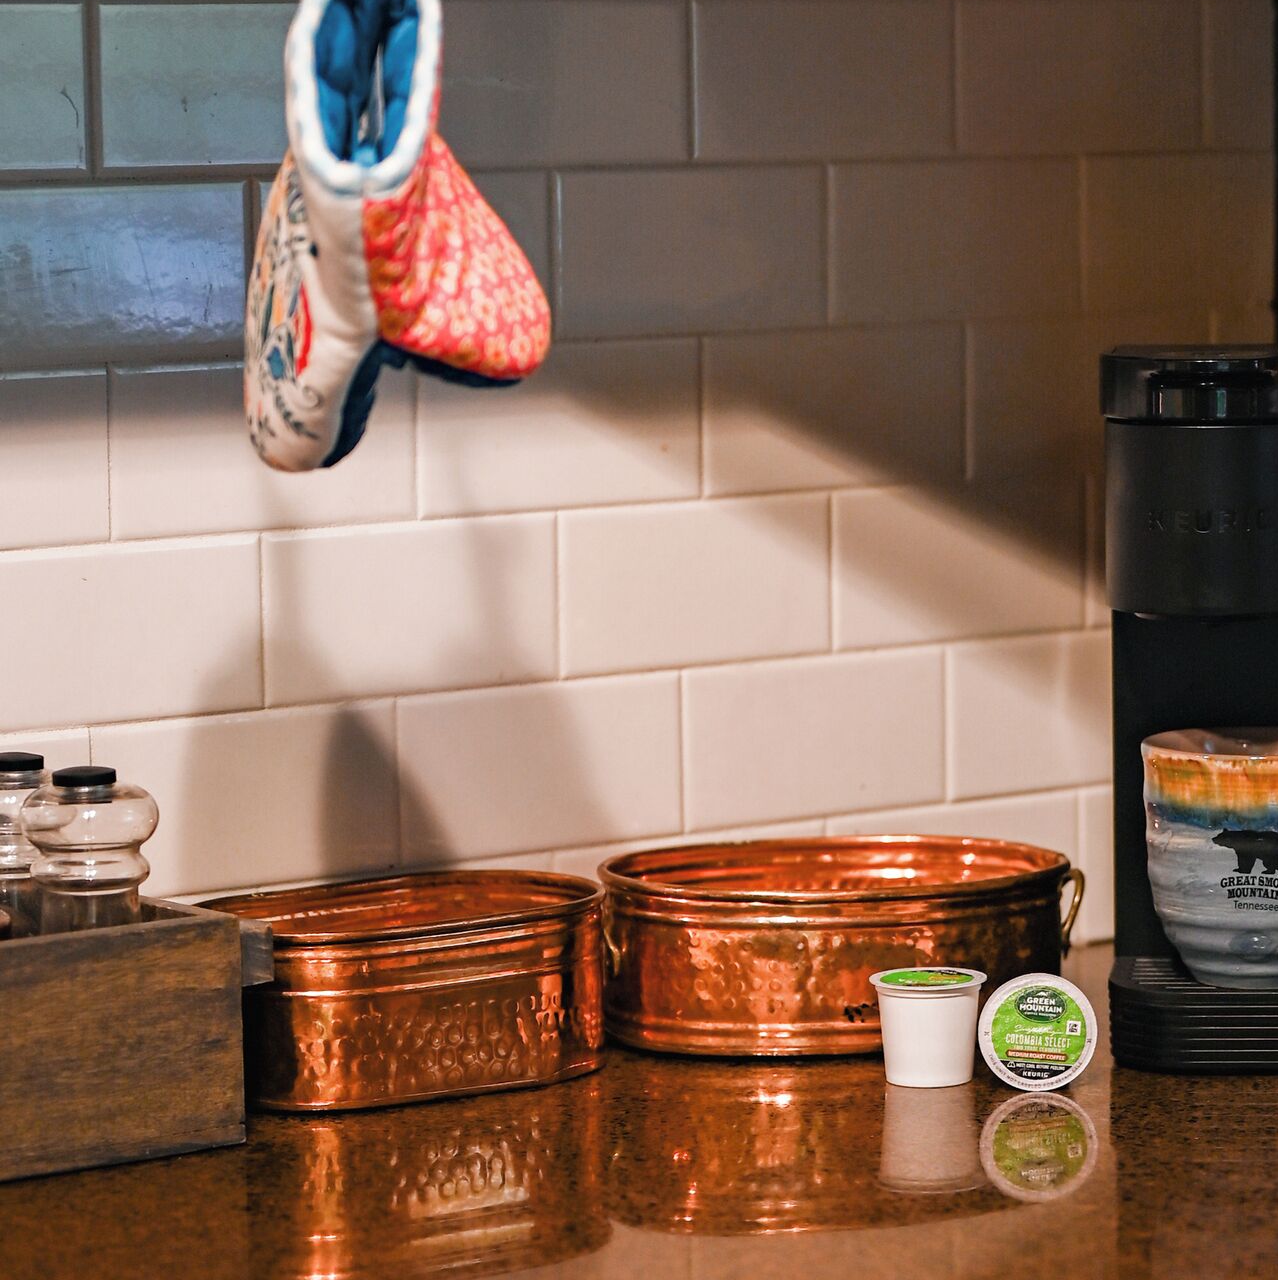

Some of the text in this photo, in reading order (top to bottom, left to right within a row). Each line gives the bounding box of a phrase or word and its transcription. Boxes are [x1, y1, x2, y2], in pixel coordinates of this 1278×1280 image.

[1220, 876, 1257, 888] GREAT
[1026, 996, 1056, 1005] GREEN
[1019, 1003, 1063, 1014] MOUNTAIN
[1005, 1033, 1071, 1048] COLOMBIA SELECT
